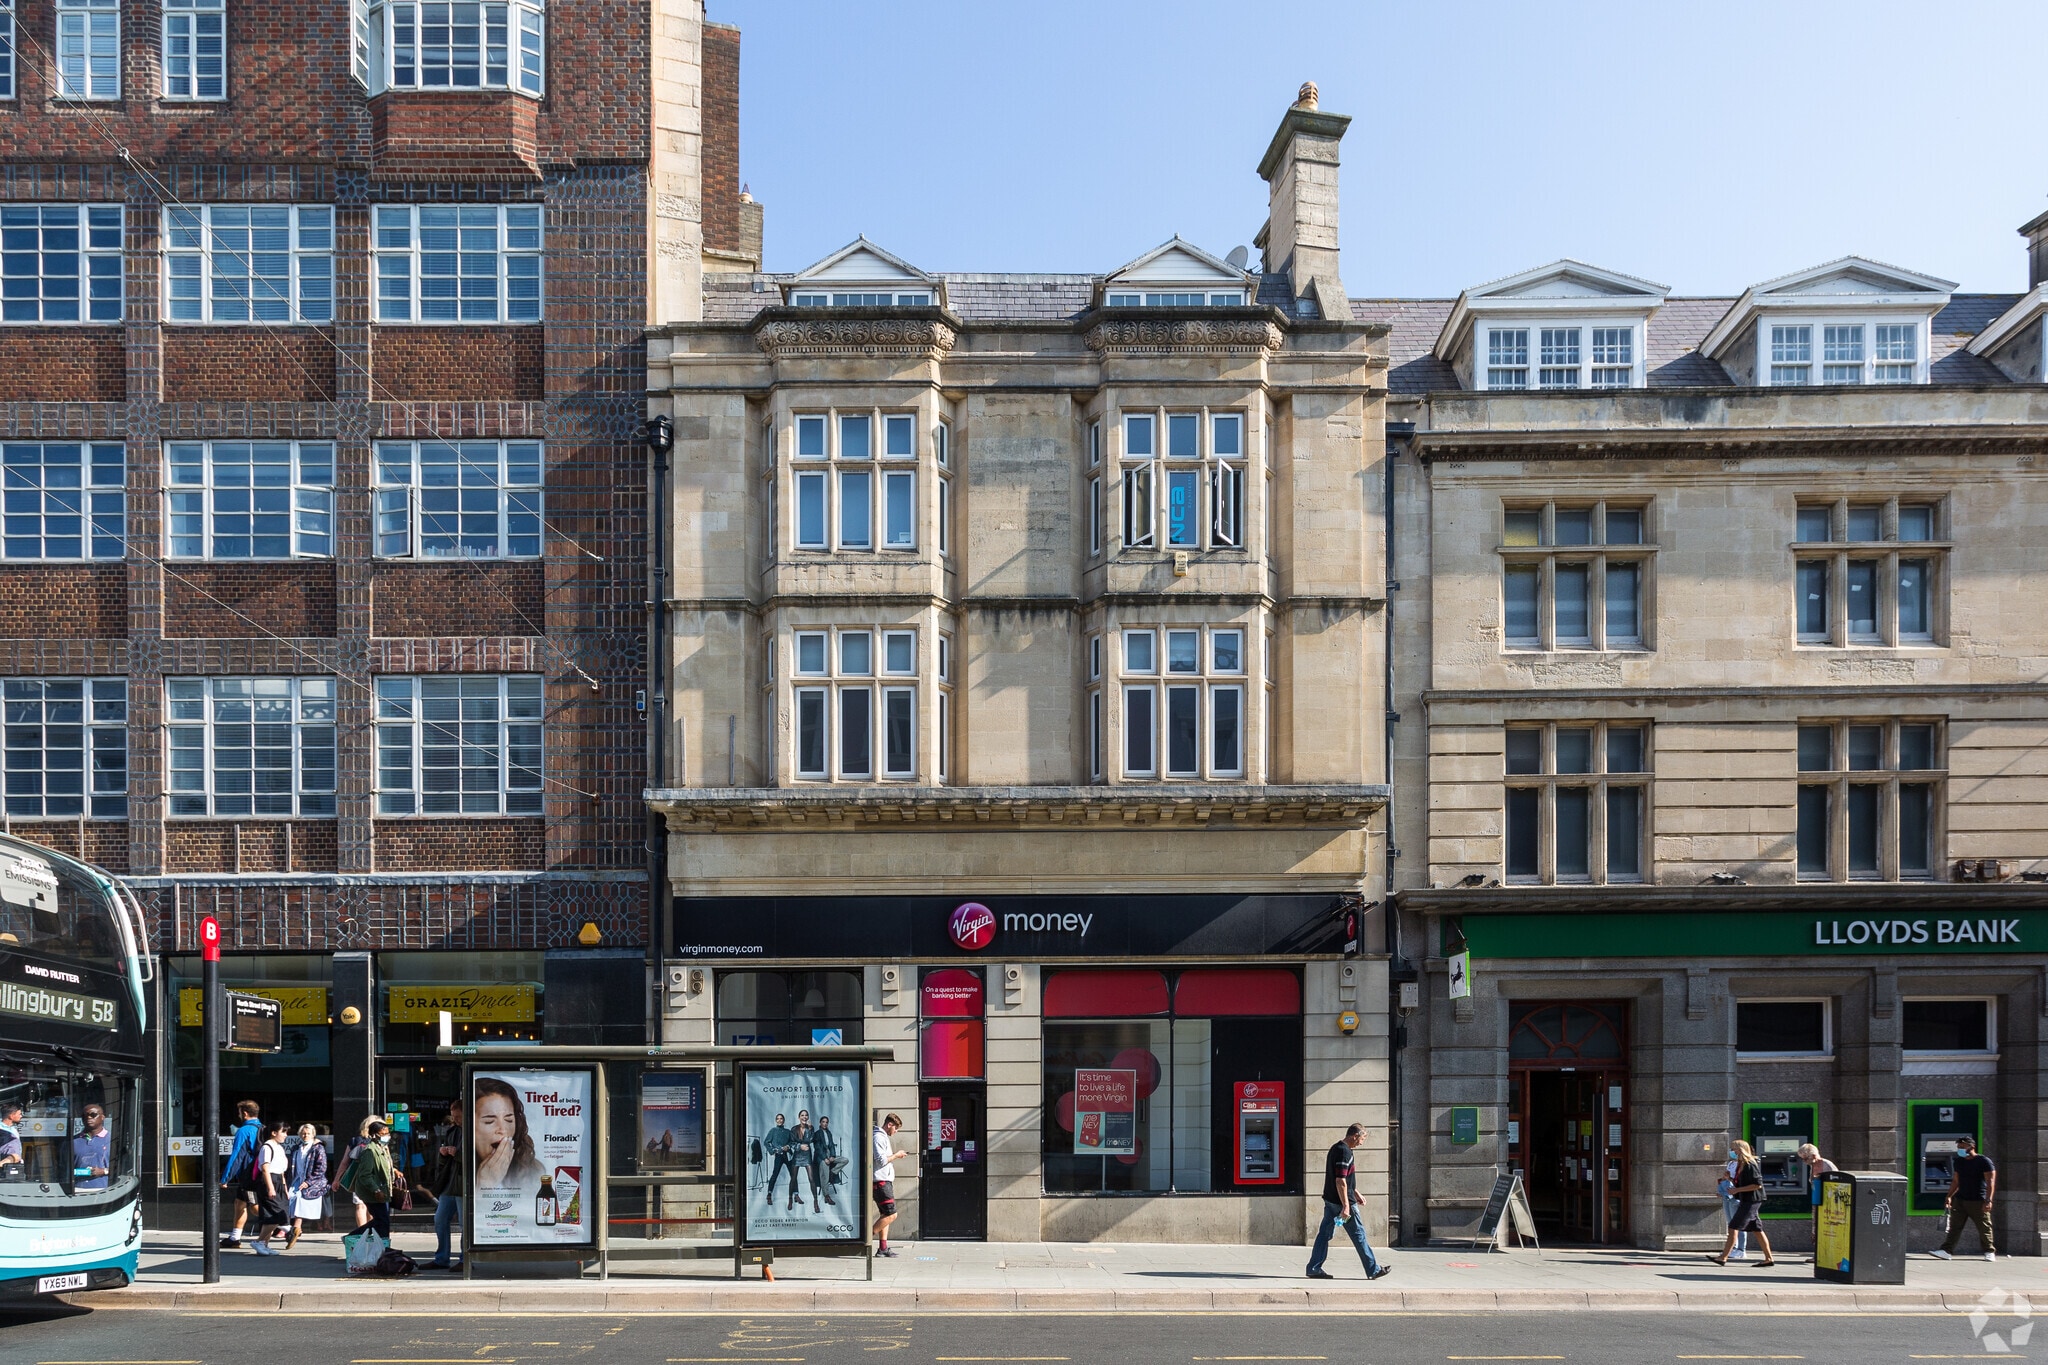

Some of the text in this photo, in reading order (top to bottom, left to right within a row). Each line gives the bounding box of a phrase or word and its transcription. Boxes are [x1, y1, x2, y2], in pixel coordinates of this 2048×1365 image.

[206, 921, 217, 940] B
[953, 907, 1093, 943] Virgin money
[1816, 919, 2020, 944] LLOYDS BANK
[680, 943, 763, 956] virginmoney.com
[25, 964, 80, 984] DAVID RUTTER
[932, 992, 954, 1000] banking
[940, 986, 955, 994] quest
[0, 983, 114, 1023] llingbury 5B
[404, 988, 519, 1011] GRAZIE Mille
[1079, 1073, 1111, 1081] It's time
[1079, 1083, 1088, 1091] to
[1089, 1083, 1104, 1091] live
[1112, 1083, 1126, 1091] life
[524, 1091, 558, 1103] Tired
[1103, 1093, 1128, 1103] Virgin
[543, 1105, 581, 1116] Tired?
[826, 1224, 854, 1233] ecco
[43, 1275, 84, 1290] YX69 NWL
